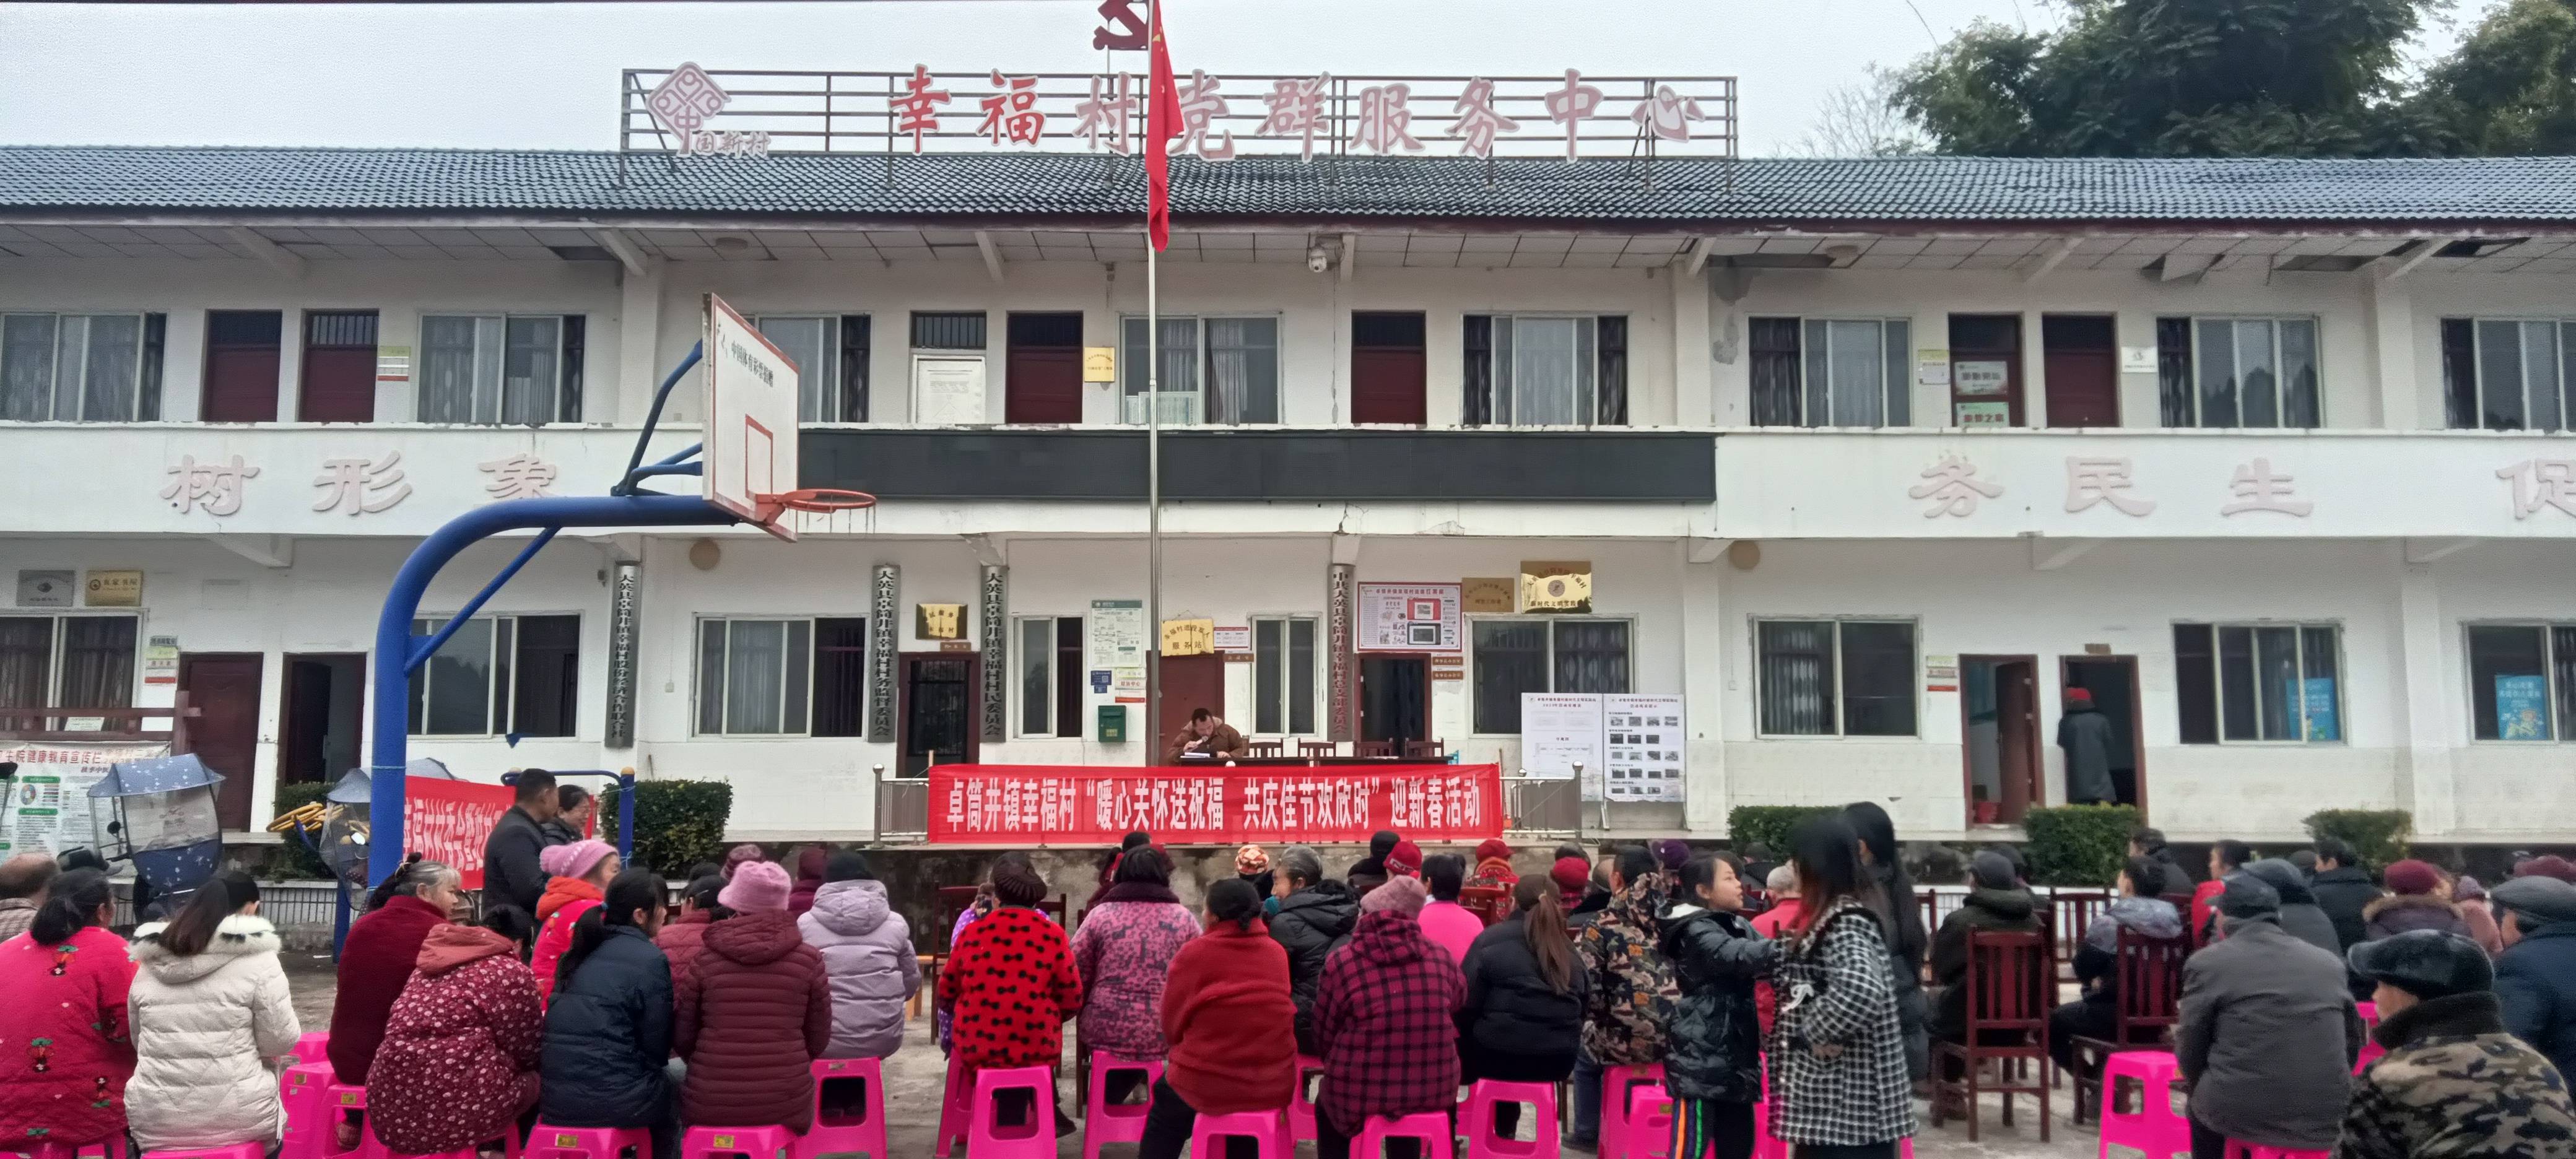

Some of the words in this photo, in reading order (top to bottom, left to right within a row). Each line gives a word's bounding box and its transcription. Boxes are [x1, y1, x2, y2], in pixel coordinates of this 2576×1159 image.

[887, 64, 1707, 162] 幸福村党群服务中心
[731, 340, 773, 388] 中国体育彩票捐赠
